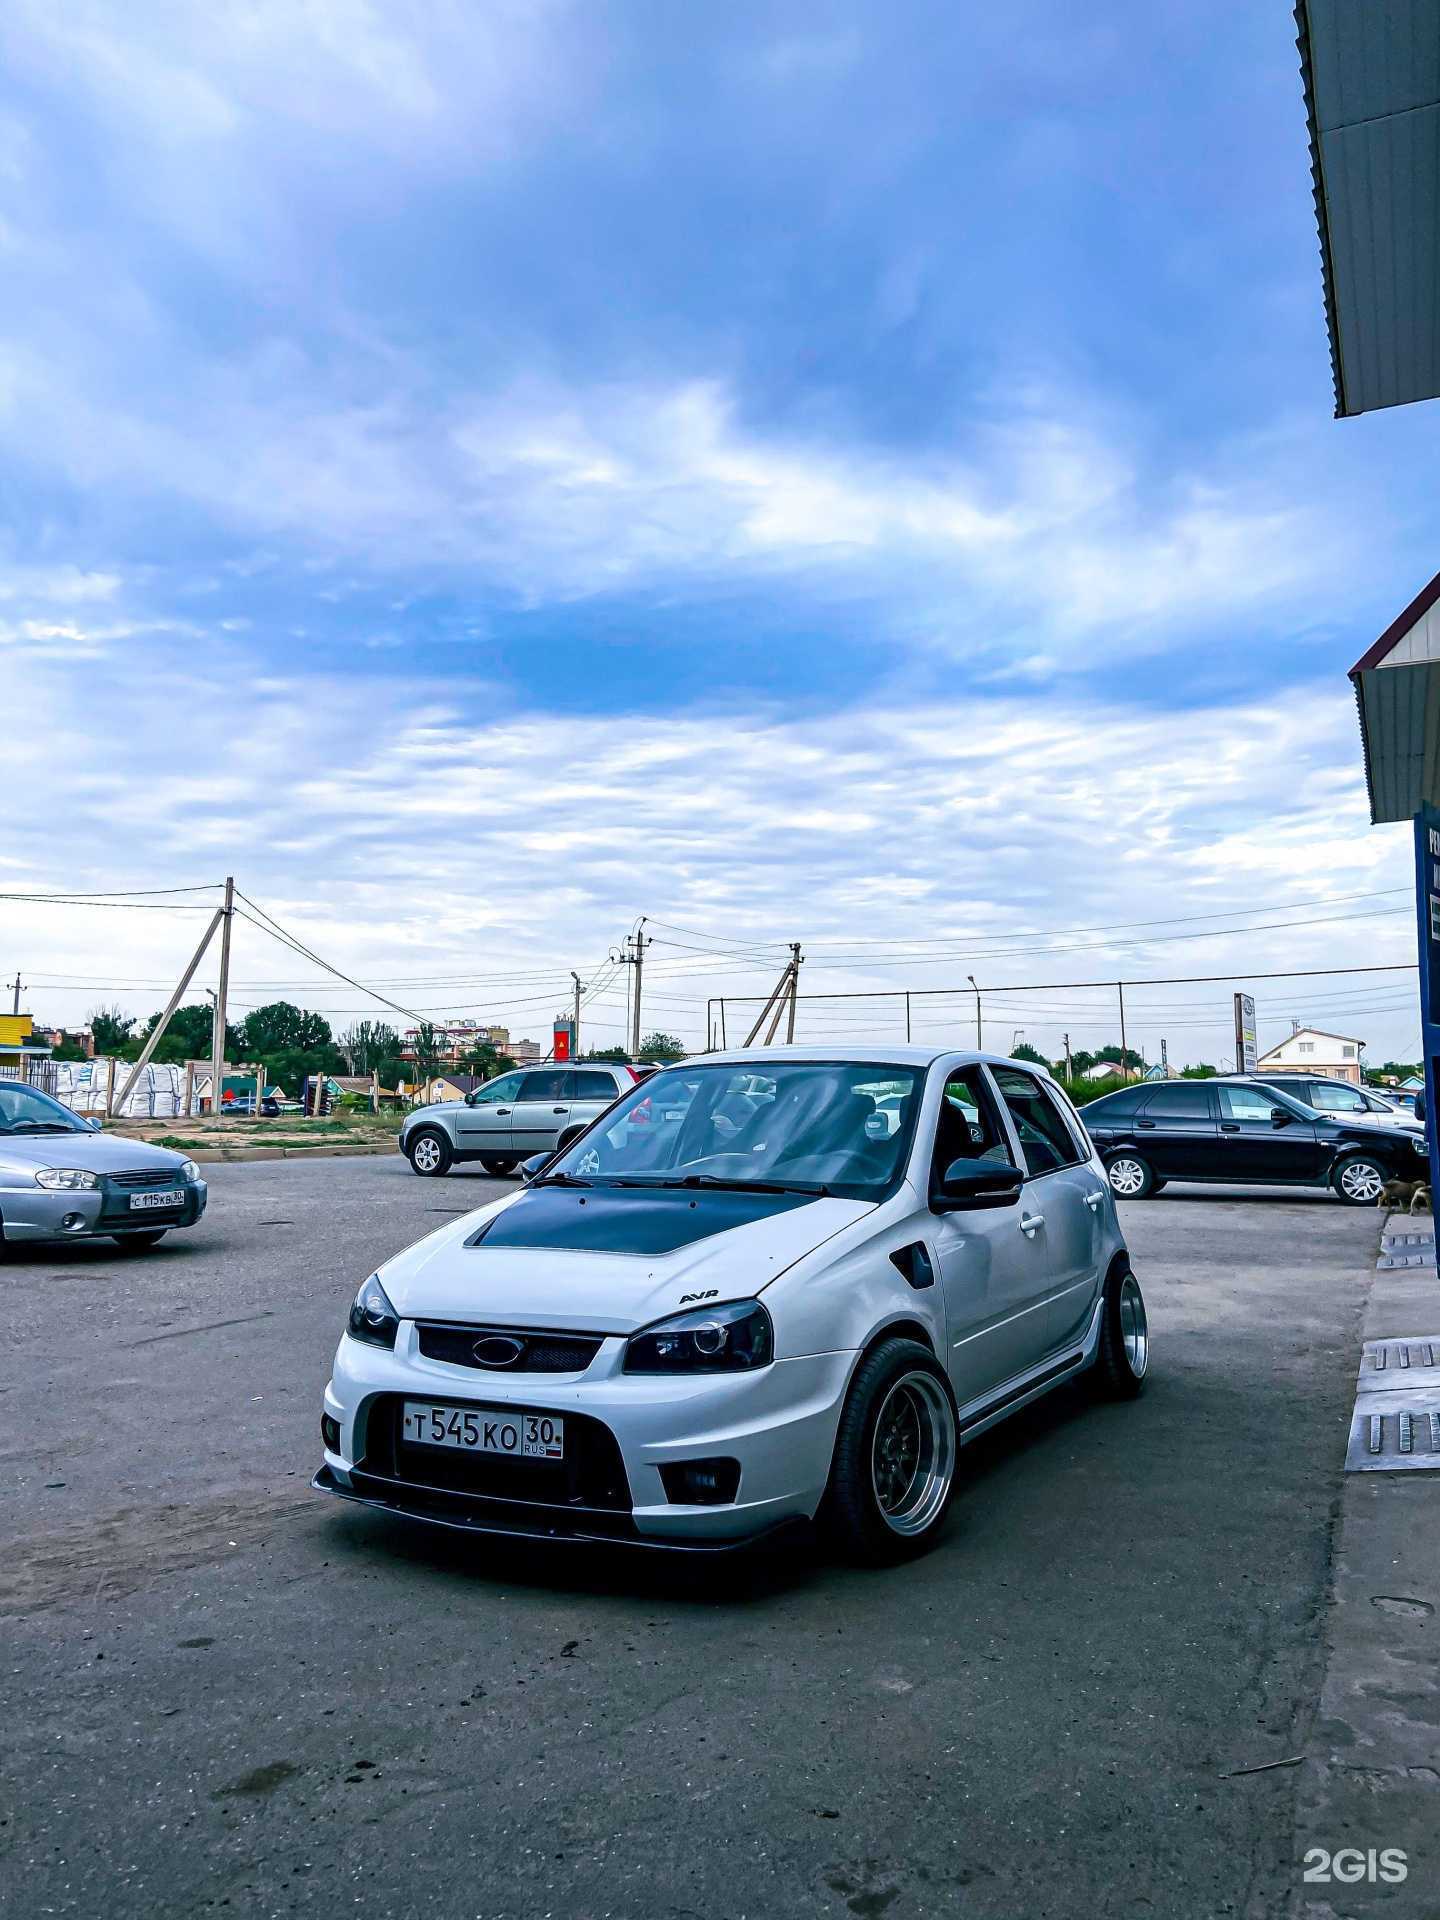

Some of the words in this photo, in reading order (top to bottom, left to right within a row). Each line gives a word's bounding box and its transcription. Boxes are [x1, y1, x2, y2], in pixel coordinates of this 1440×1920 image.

[679, 1289, 719, 1305] AVR
[526, 1416, 554, 1444] 30
[524, 1443, 545, 1456] RUS
